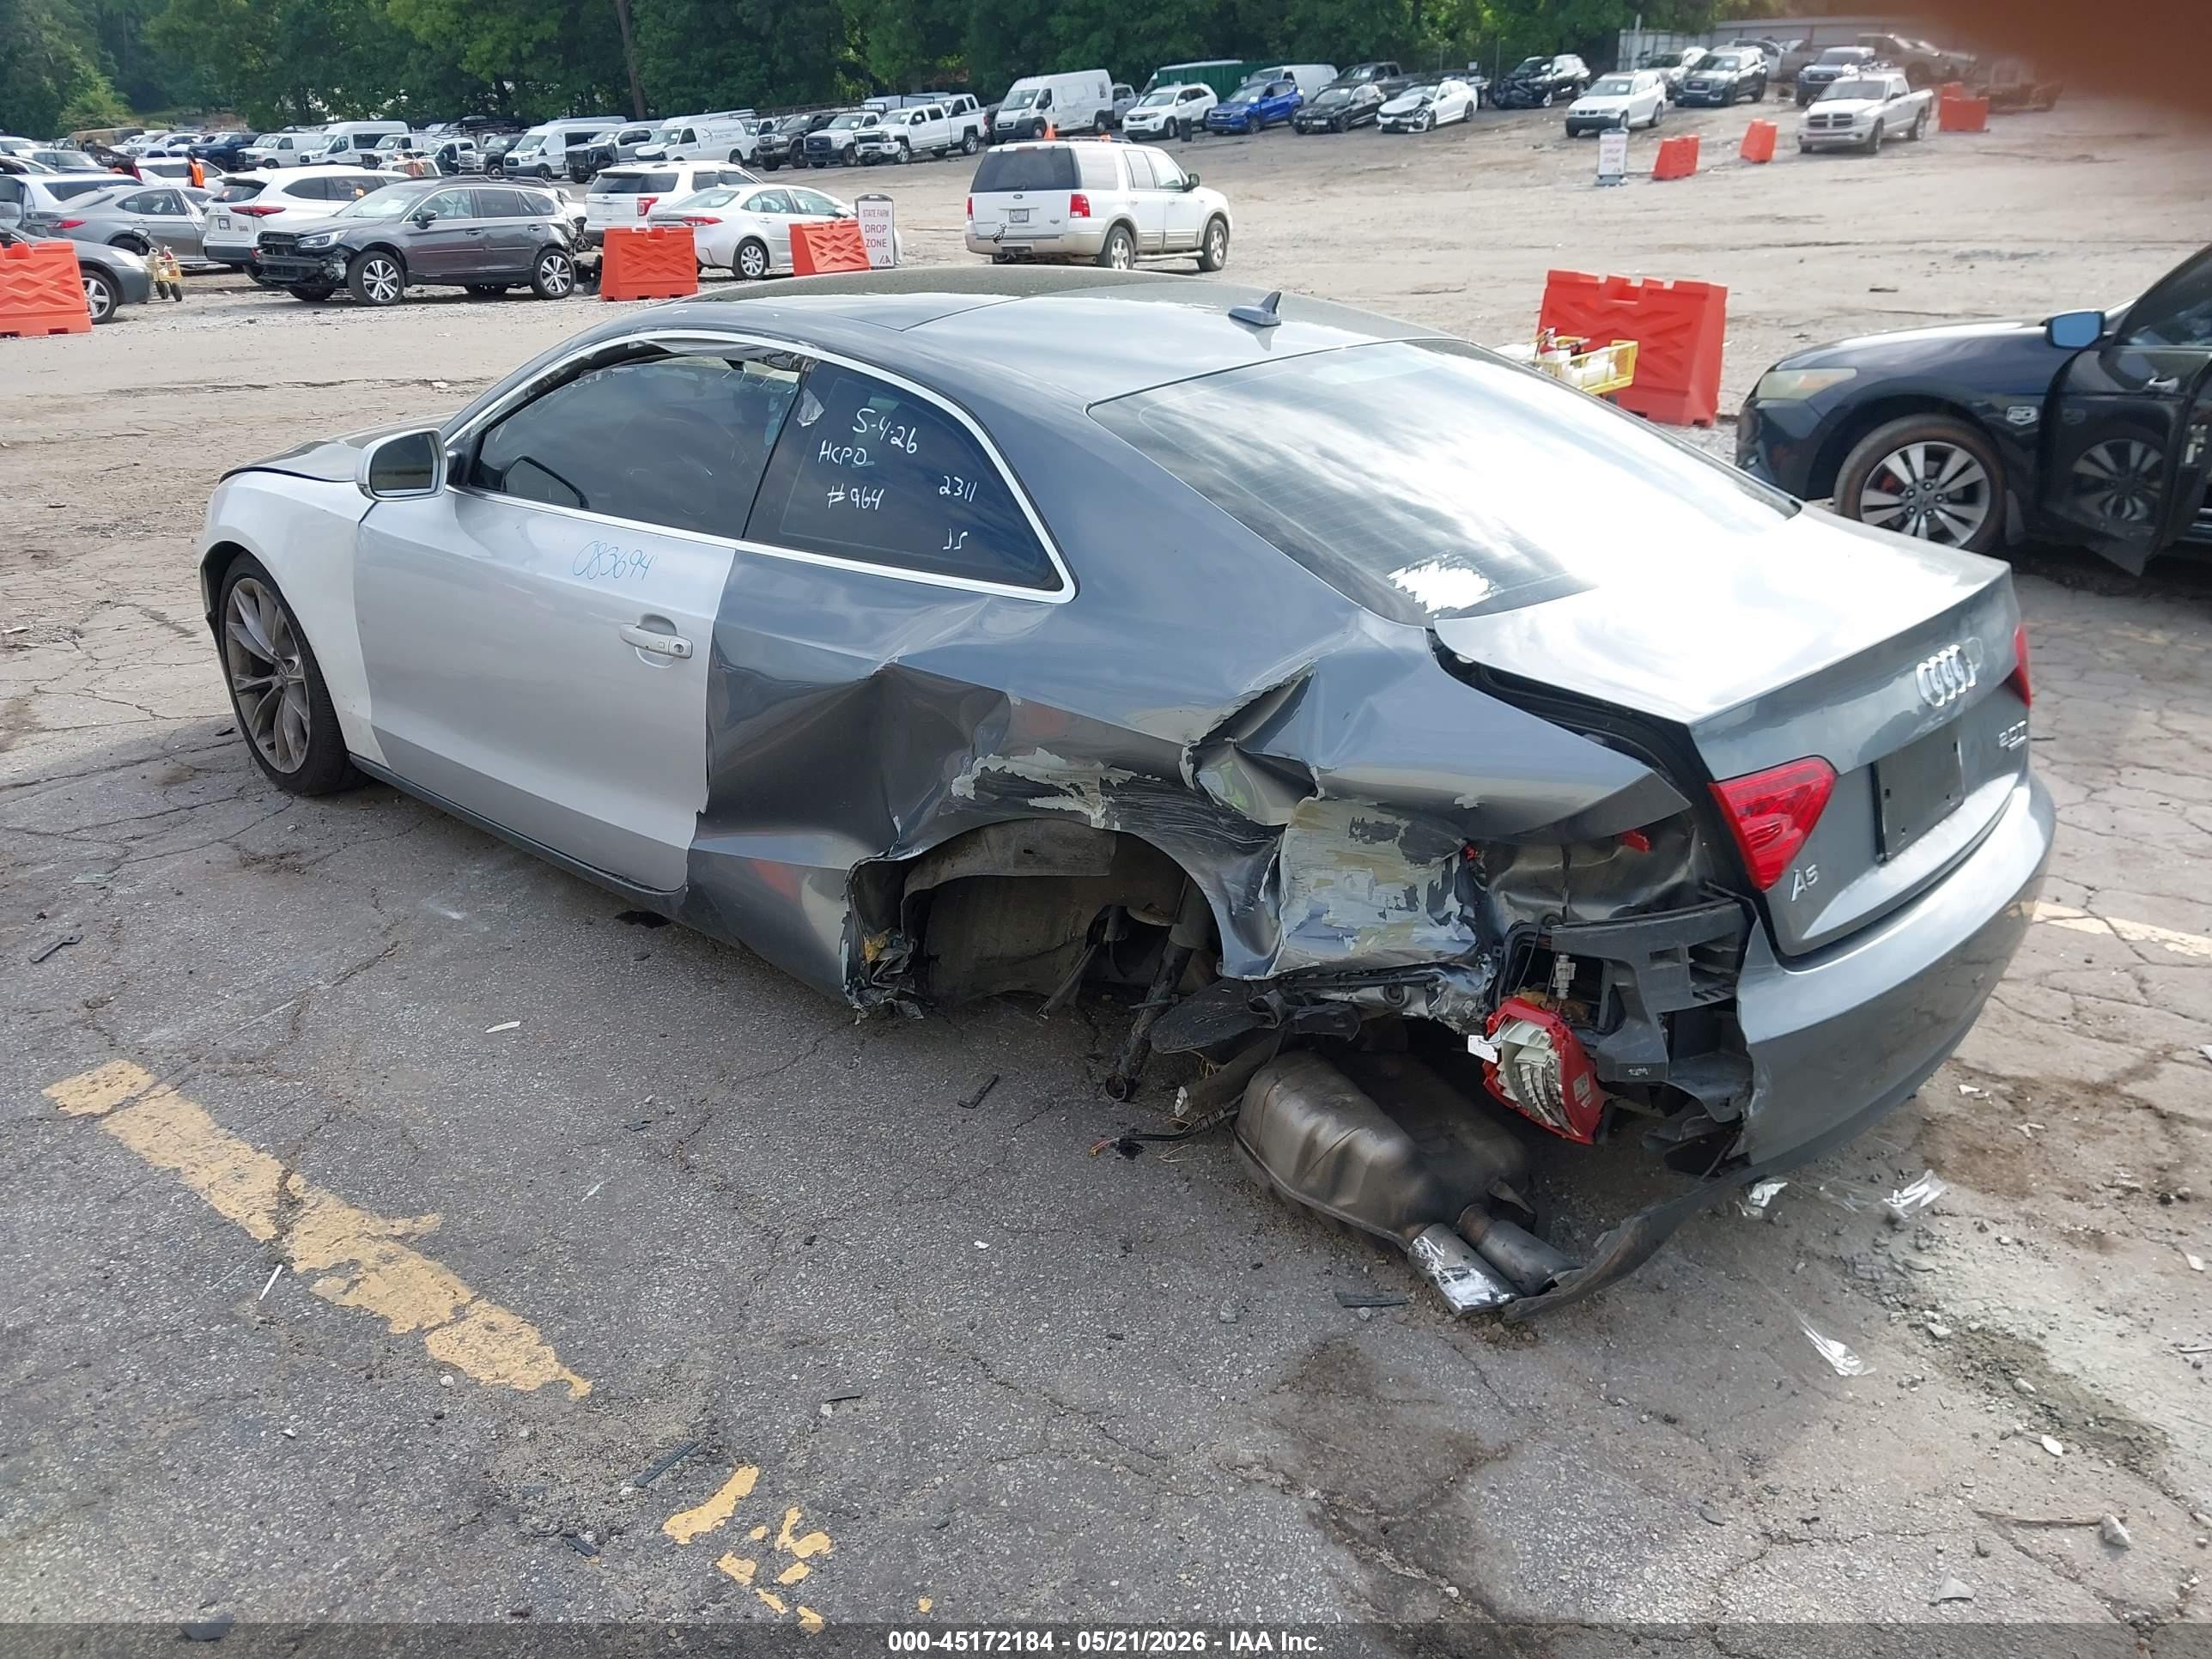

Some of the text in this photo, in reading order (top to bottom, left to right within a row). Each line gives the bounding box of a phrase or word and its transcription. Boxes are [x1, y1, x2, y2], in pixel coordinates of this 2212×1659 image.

[862, 209, 890, 218] STATE FARM
[865, 224, 888, 234] DROP
[866, 239, 888, 248] ZONE
[818, 439, 868, 467] HCPD
[939, 475, 978, 502] 2311
[1790, 864, 1820, 902] A5
